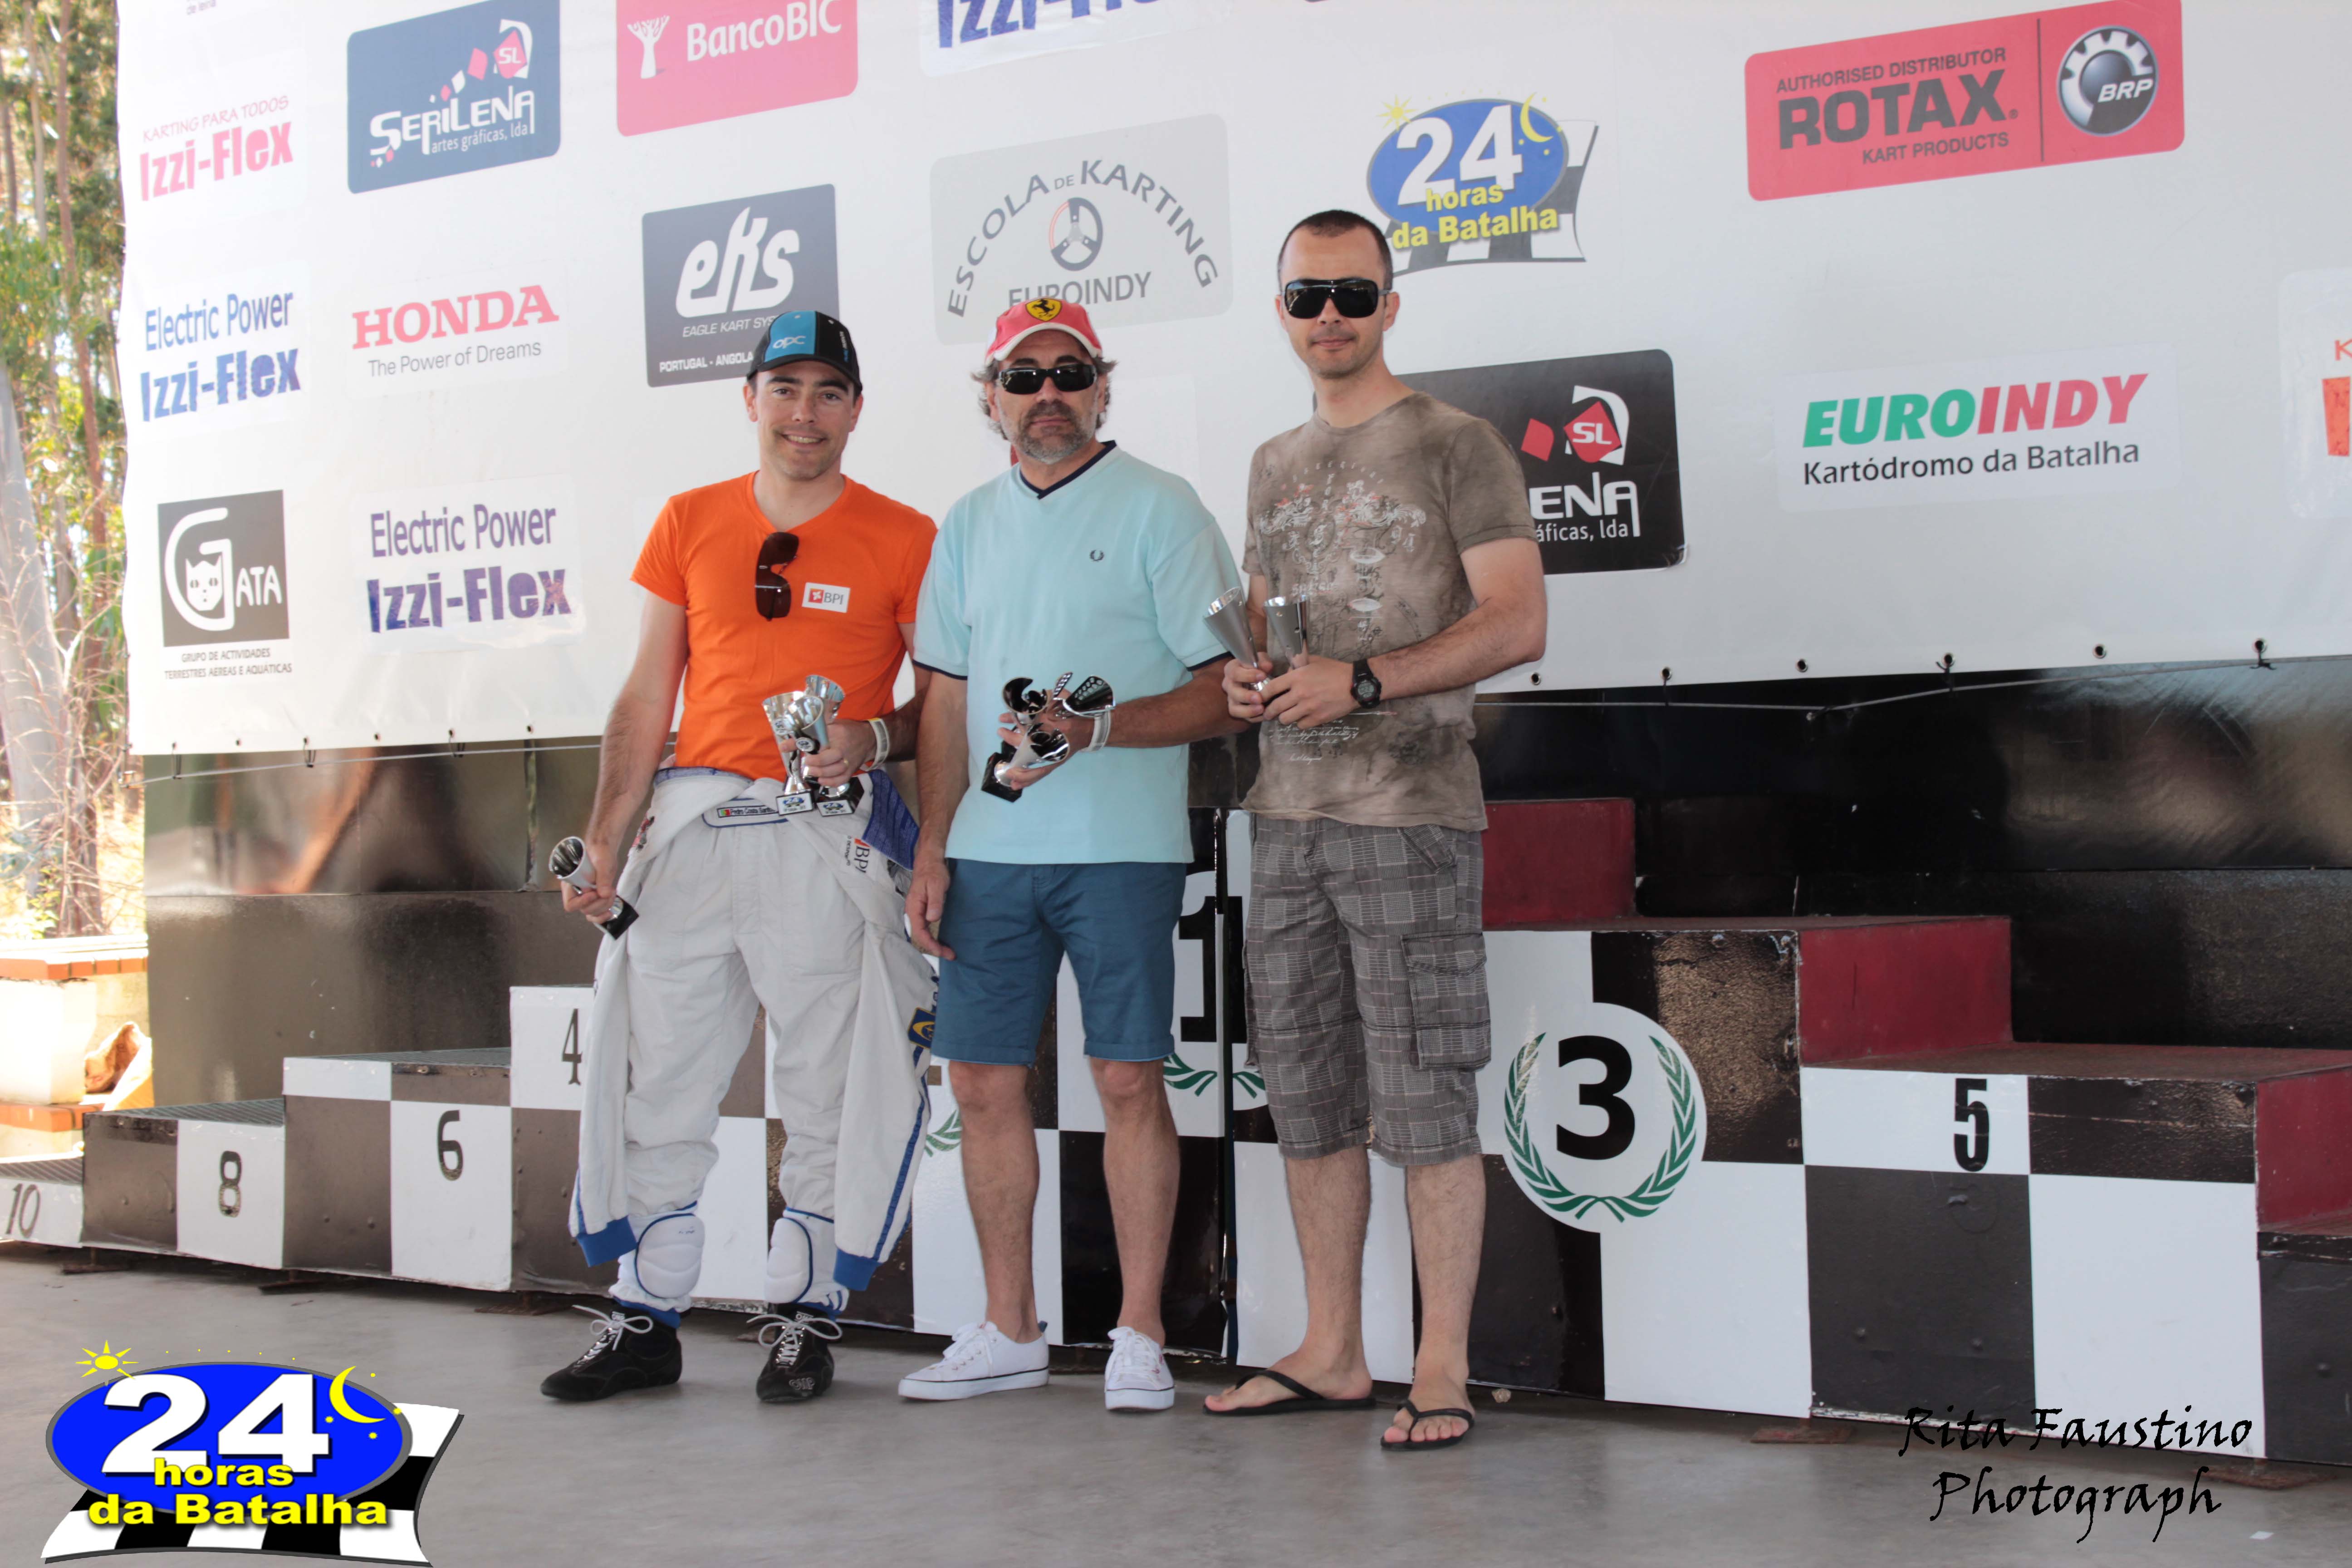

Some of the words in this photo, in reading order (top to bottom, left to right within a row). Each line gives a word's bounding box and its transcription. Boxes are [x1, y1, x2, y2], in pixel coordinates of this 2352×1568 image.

[498, 48, 521, 64] SL
[687, 0, 842, 62] BancoBIC
[1776, 64, 1884, 93] AUTHORISED
[1889, 47, 2007, 78] DISTRIBUTOR
[2097, 78, 2153, 103] BRP
[142, 117, 199, 143] KARTING
[202, 108, 239, 129] PARA
[241, 95, 289, 119] TODOS
[431, 138, 458, 153] artes
[461, 129, 507, 152] gráficas,
[510, 123, 528, 138] lda
[140, 121, 294, 201] Izzi-Flex
[1396, 104, 1523, 206] 24
[1862, 145, 1907, 165] KART
[1912, 132, 2009, 159] PRODUCTS
[1426, 184, 1504, 212] horas
[947, 175, 1050, 317] ESCOLA
[1054, 175, 1075, 190] DE
[1080, 160, 1219, 288] KARTING
[1392, 222, 1429, 249] da
[1439, 206, 1558, 243] Batalha
[146, 299, 219, 351] Electric
[227, 292, 294, 336] Power
[352, 284, 559, 349] HONDA
[683, 323, 717, 338] EAGLE
[720, 319, 750, 333] KART
[753, 315, 775, 328] SYS
[368, 360, 396, 377] The
[401, 354, 451, 373] Power
[455, 347, 472, 366] of
[477, 342, 542, 363] Dreams
[659, 357, 707, 372] PORTUGAL
[715, 351, 754, 365] ANGOLA
[140, 348, 301, 422] Izzi-Flex
[1572, 422, 1612, 445] SL
[1803, 373, 2149, 448] EUROINDY
[1804, 456, 1973, 485] Kartódromo
[1983, 450, 2017, 473] da
[2028, 440, 2139, 470] Batalha
[370, 506, 466, 557] Electric
[473, 504, 557, 549] Power
[1536, 523, 1594, 542] áficas,
[1600, 519, 1628, 539] lda
[367, 566, 572, 633] Izzi-Flex
[823, 592, 844, 605] BPI
[164, 668, 206, 679] TERRESTRES
[239, 666, 243, 675] E
[181, 652, 206, 662] GRUPO
[209, 651, 218, 661] DE
[220, 647, 271, 660] ACTIVIDADES
[1180, 895, 1246, 1043] 1
[561, 1008, 583, 1086] 4
[1556, 1034, 1636, 1161] 3
[436, 1110, 464, 1181] 6
[1953, 1078, 1990, 1172] 5
[218, 1150, 243, 1218] 8
[5, 1183, 42, 1239] 10
